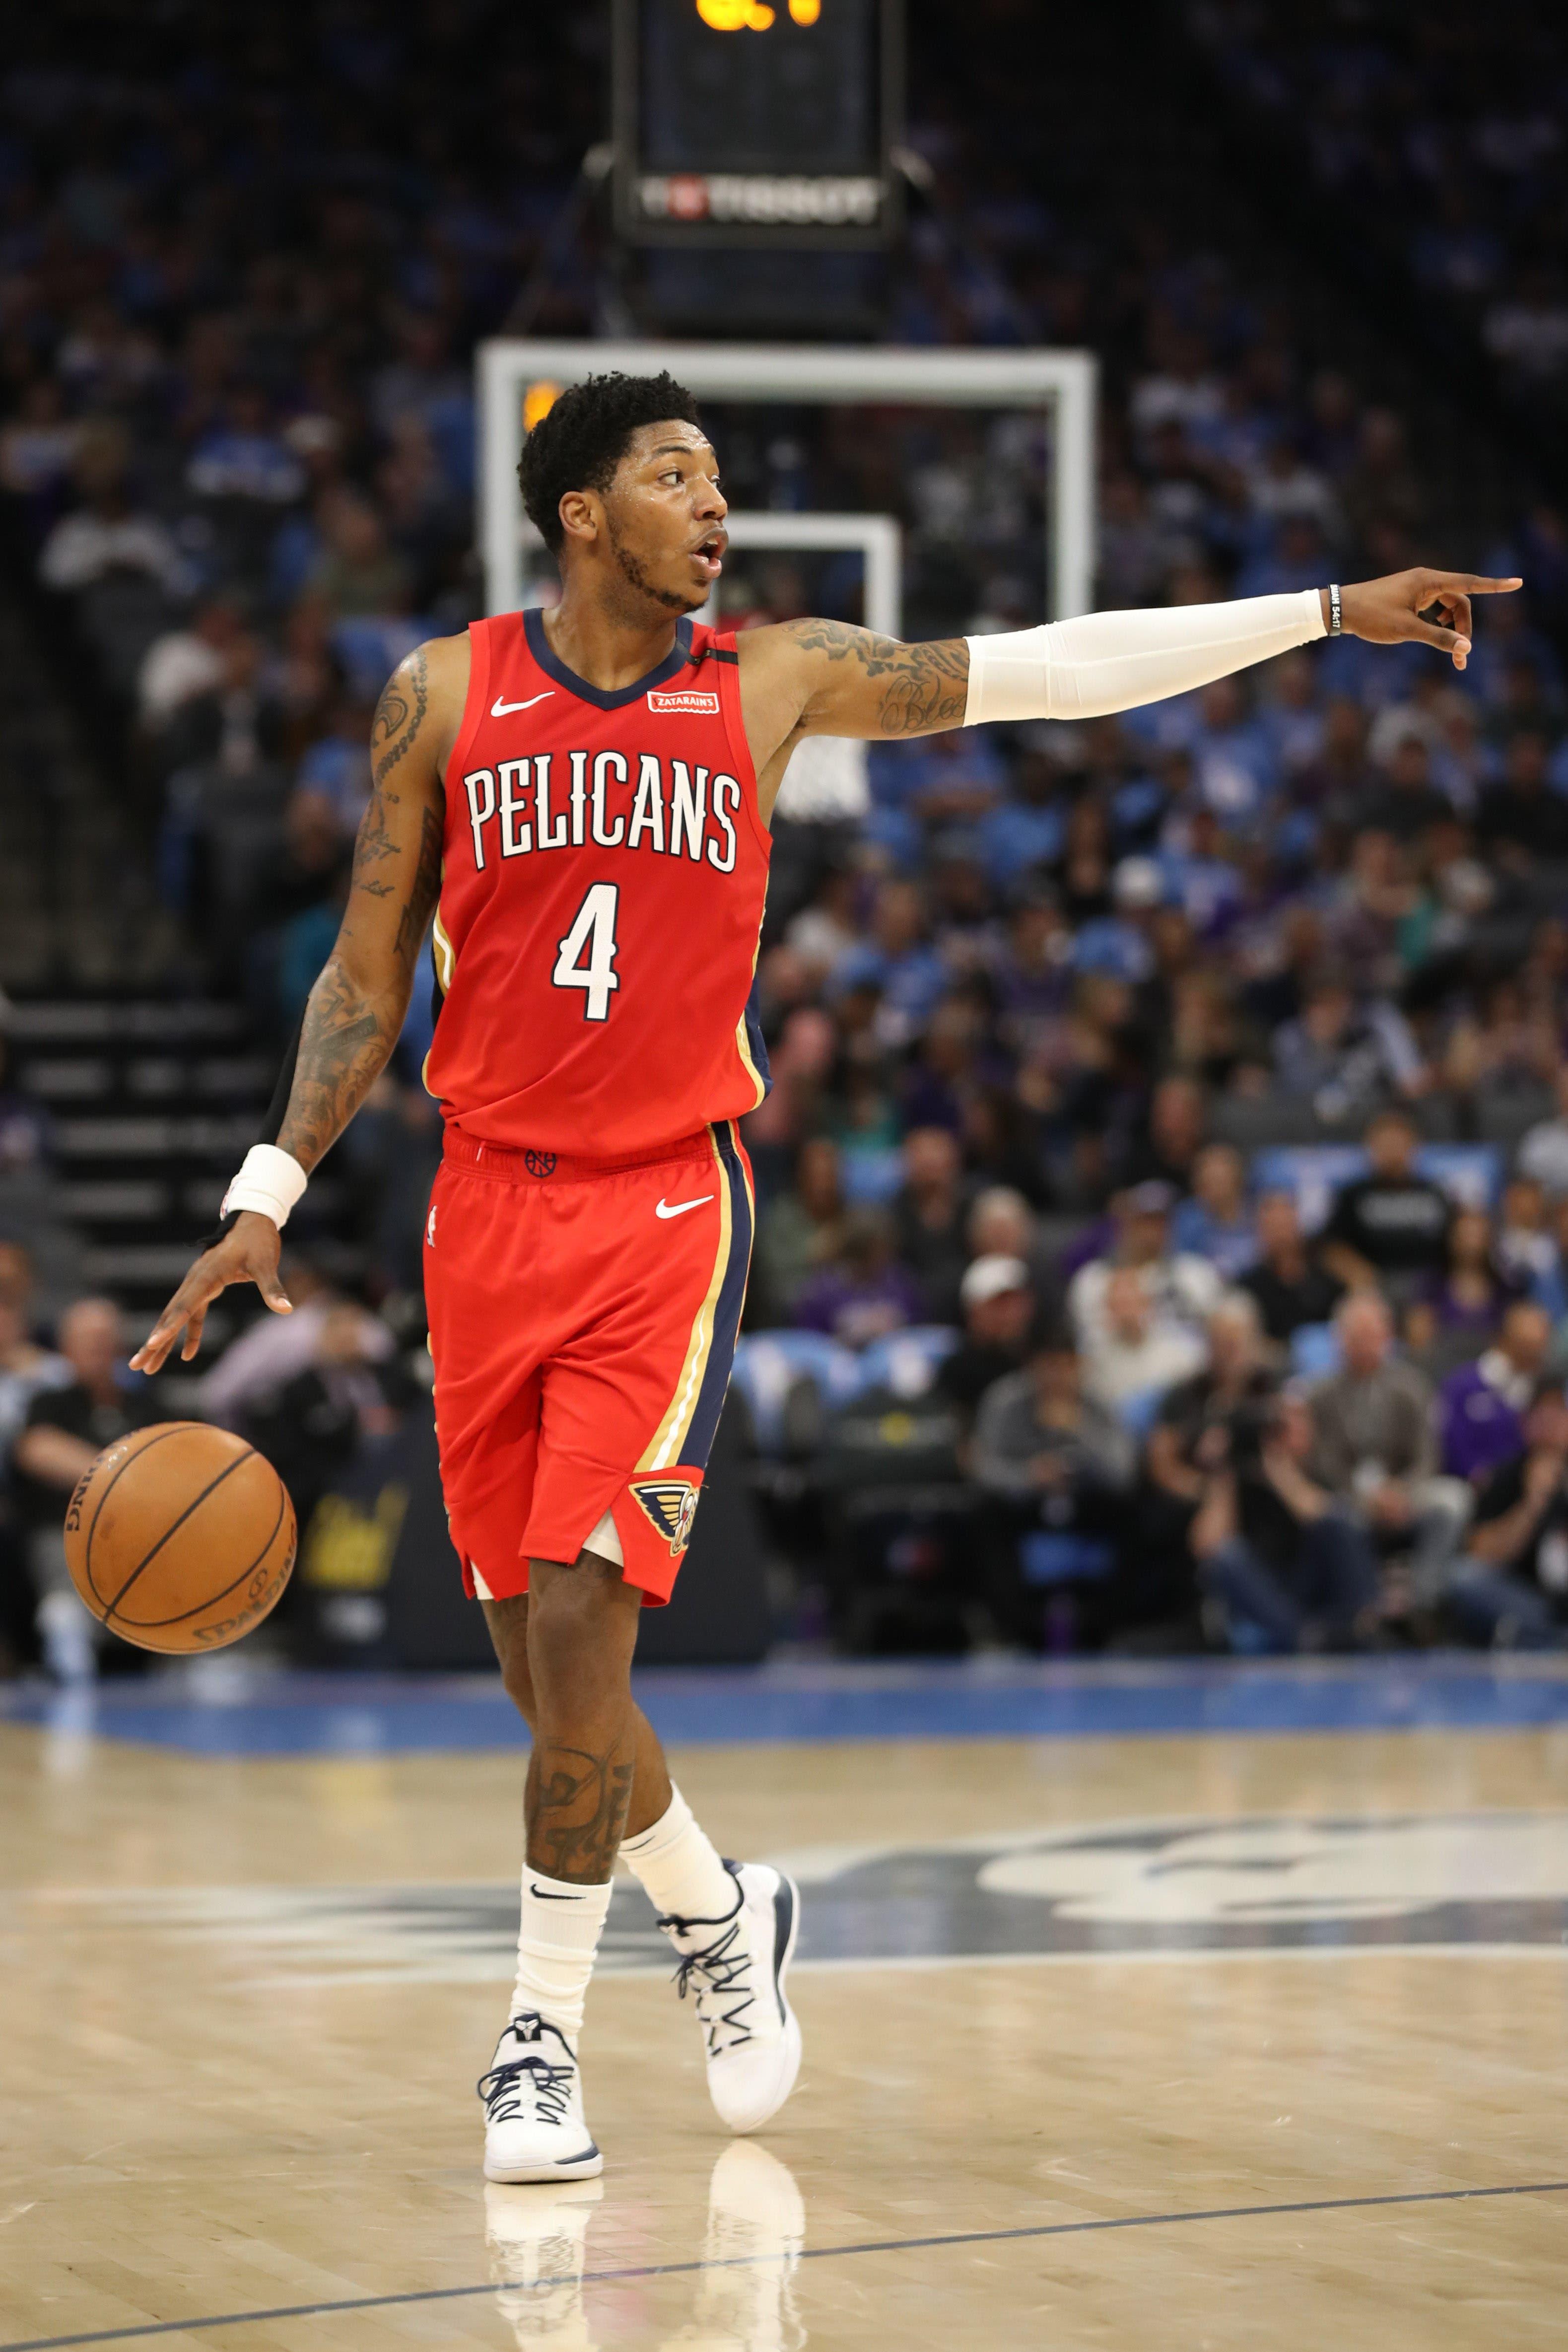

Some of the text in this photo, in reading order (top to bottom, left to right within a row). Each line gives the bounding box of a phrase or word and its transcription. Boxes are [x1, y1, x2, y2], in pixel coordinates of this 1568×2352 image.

[1332, 606, 1341, 628] 54:17
[657, 696, 714, 707] ZATARAIN'S
[464, 750, 742, 874] PELICANS
[550, 881, 619, 1022] 4
